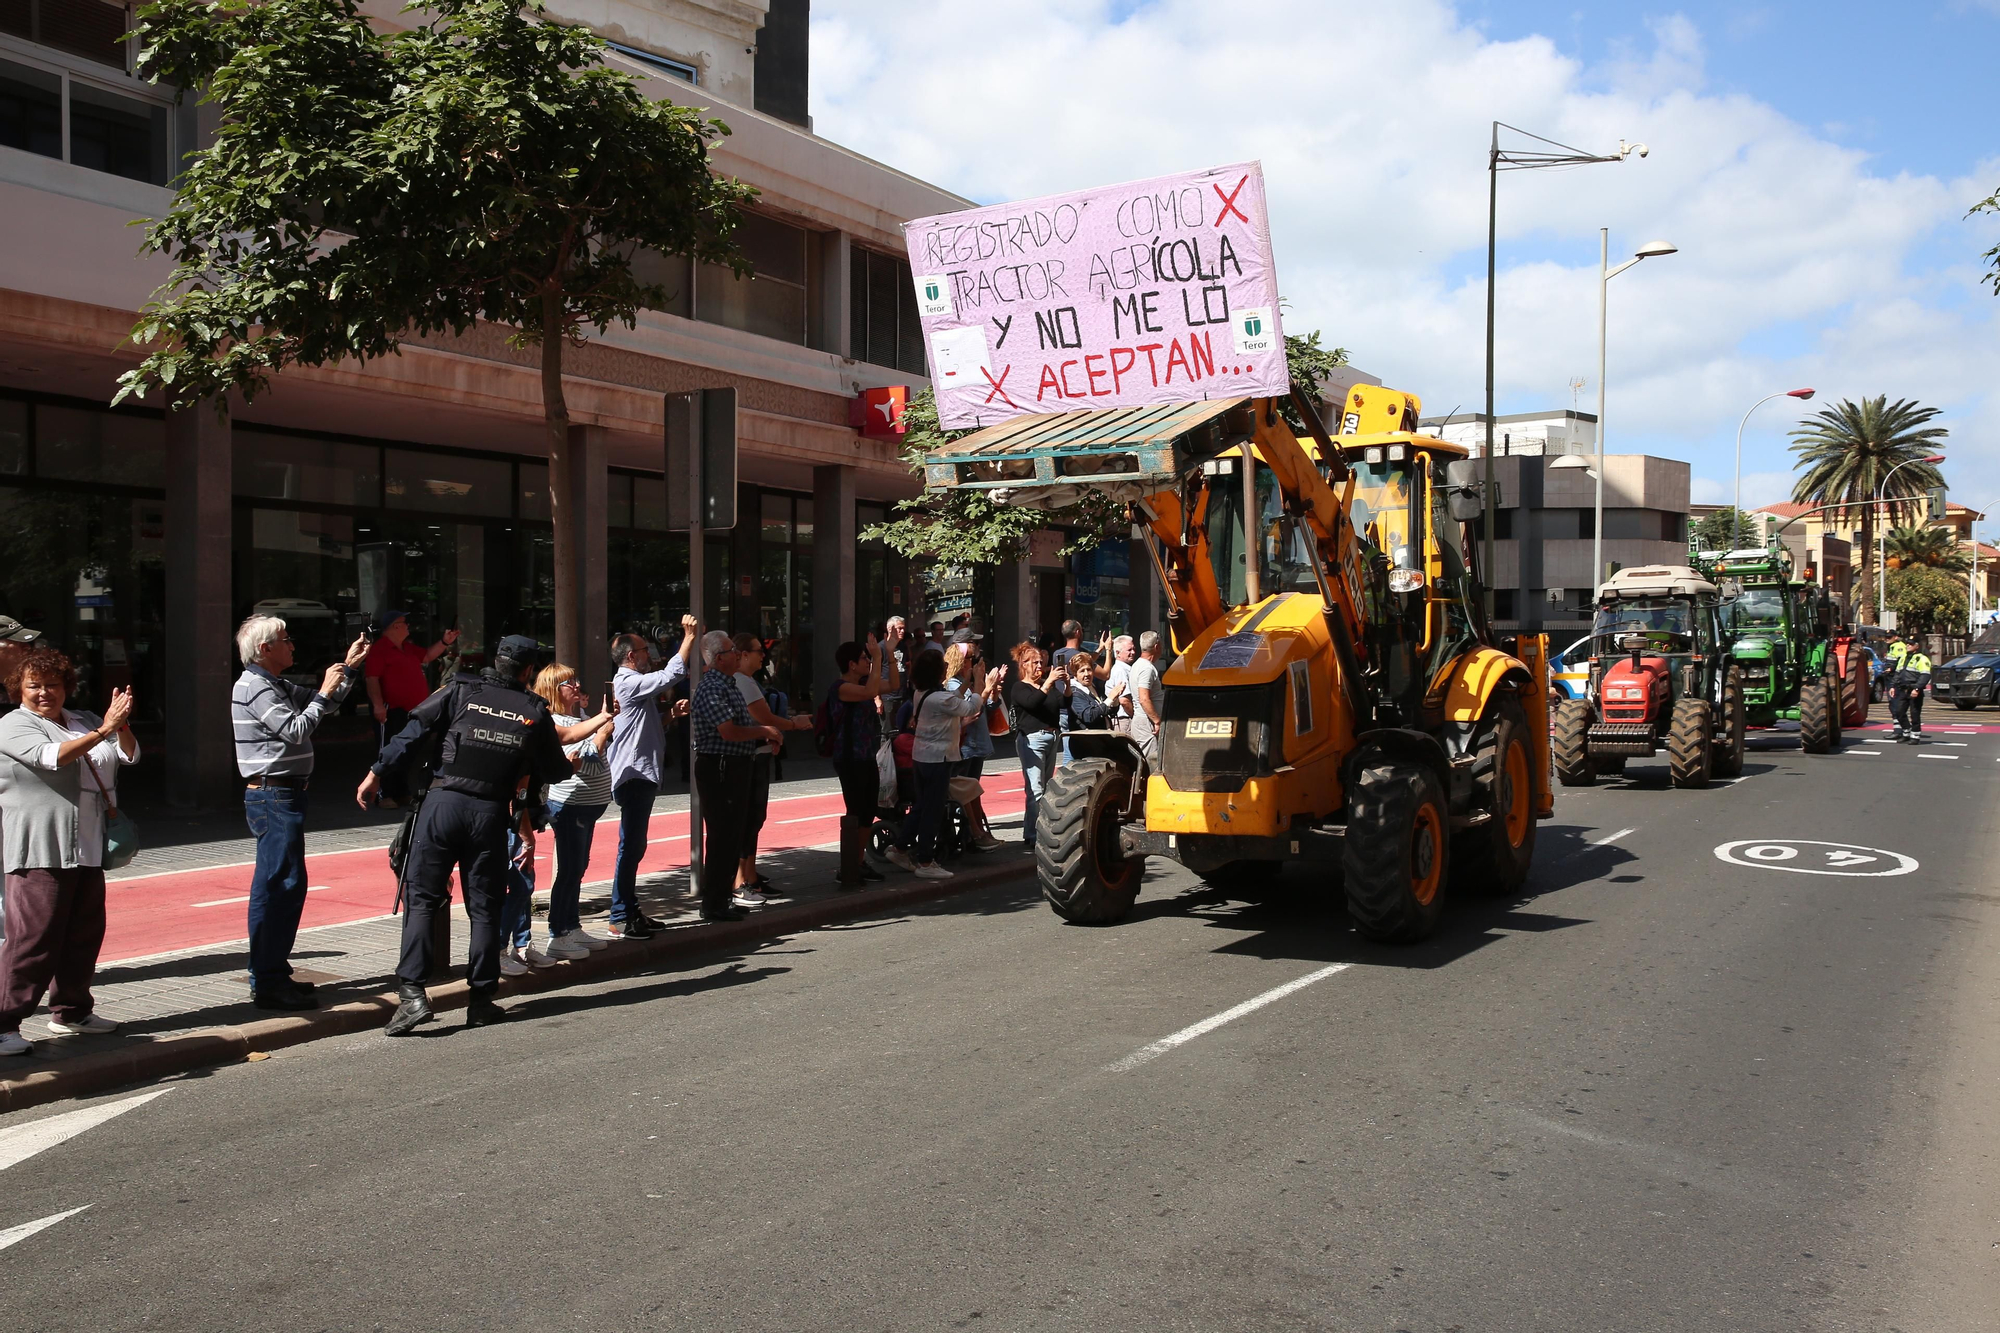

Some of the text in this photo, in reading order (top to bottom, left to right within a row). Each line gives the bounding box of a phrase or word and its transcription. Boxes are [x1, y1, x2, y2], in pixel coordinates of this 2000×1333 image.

[926, 204, 1078, 266] REGISTRADO
[1116, 187, 1204, 238] COMO
[946, 234, 1243, 313] TRACTOR AGRÍCOLA
[925, 304, 945, 313] Teror
[991, 285, 1229, 350] Y NO ME LO
[1242, 340, 1268, 350] Teror
[1076, 577, 1099, 597] beds
[1344, 554, 1365, 622] JCB
[467, 703, 526, 723] POLICIA
[1190, 720, 1233, 734] JCB
[473, 727, 523, 748] 10U254
